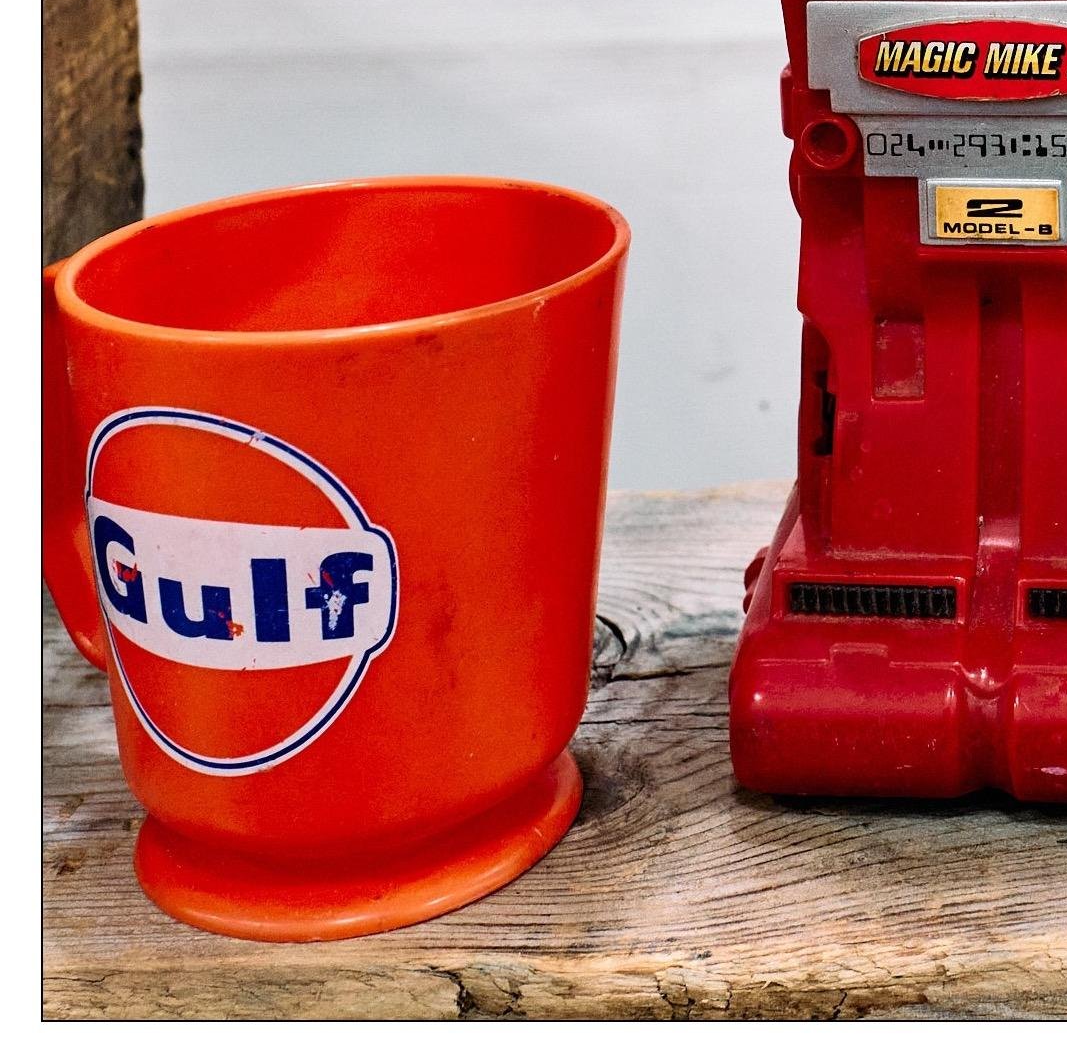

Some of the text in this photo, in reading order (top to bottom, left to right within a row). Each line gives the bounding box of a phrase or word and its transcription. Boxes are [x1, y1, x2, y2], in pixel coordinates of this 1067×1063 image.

[874, 40, 979, 78] MAGIC
[983, 43, 1064, 79] MIKE
[966, 198, 1024, 219] 2
[94, 515, 374, 643] Gulf
